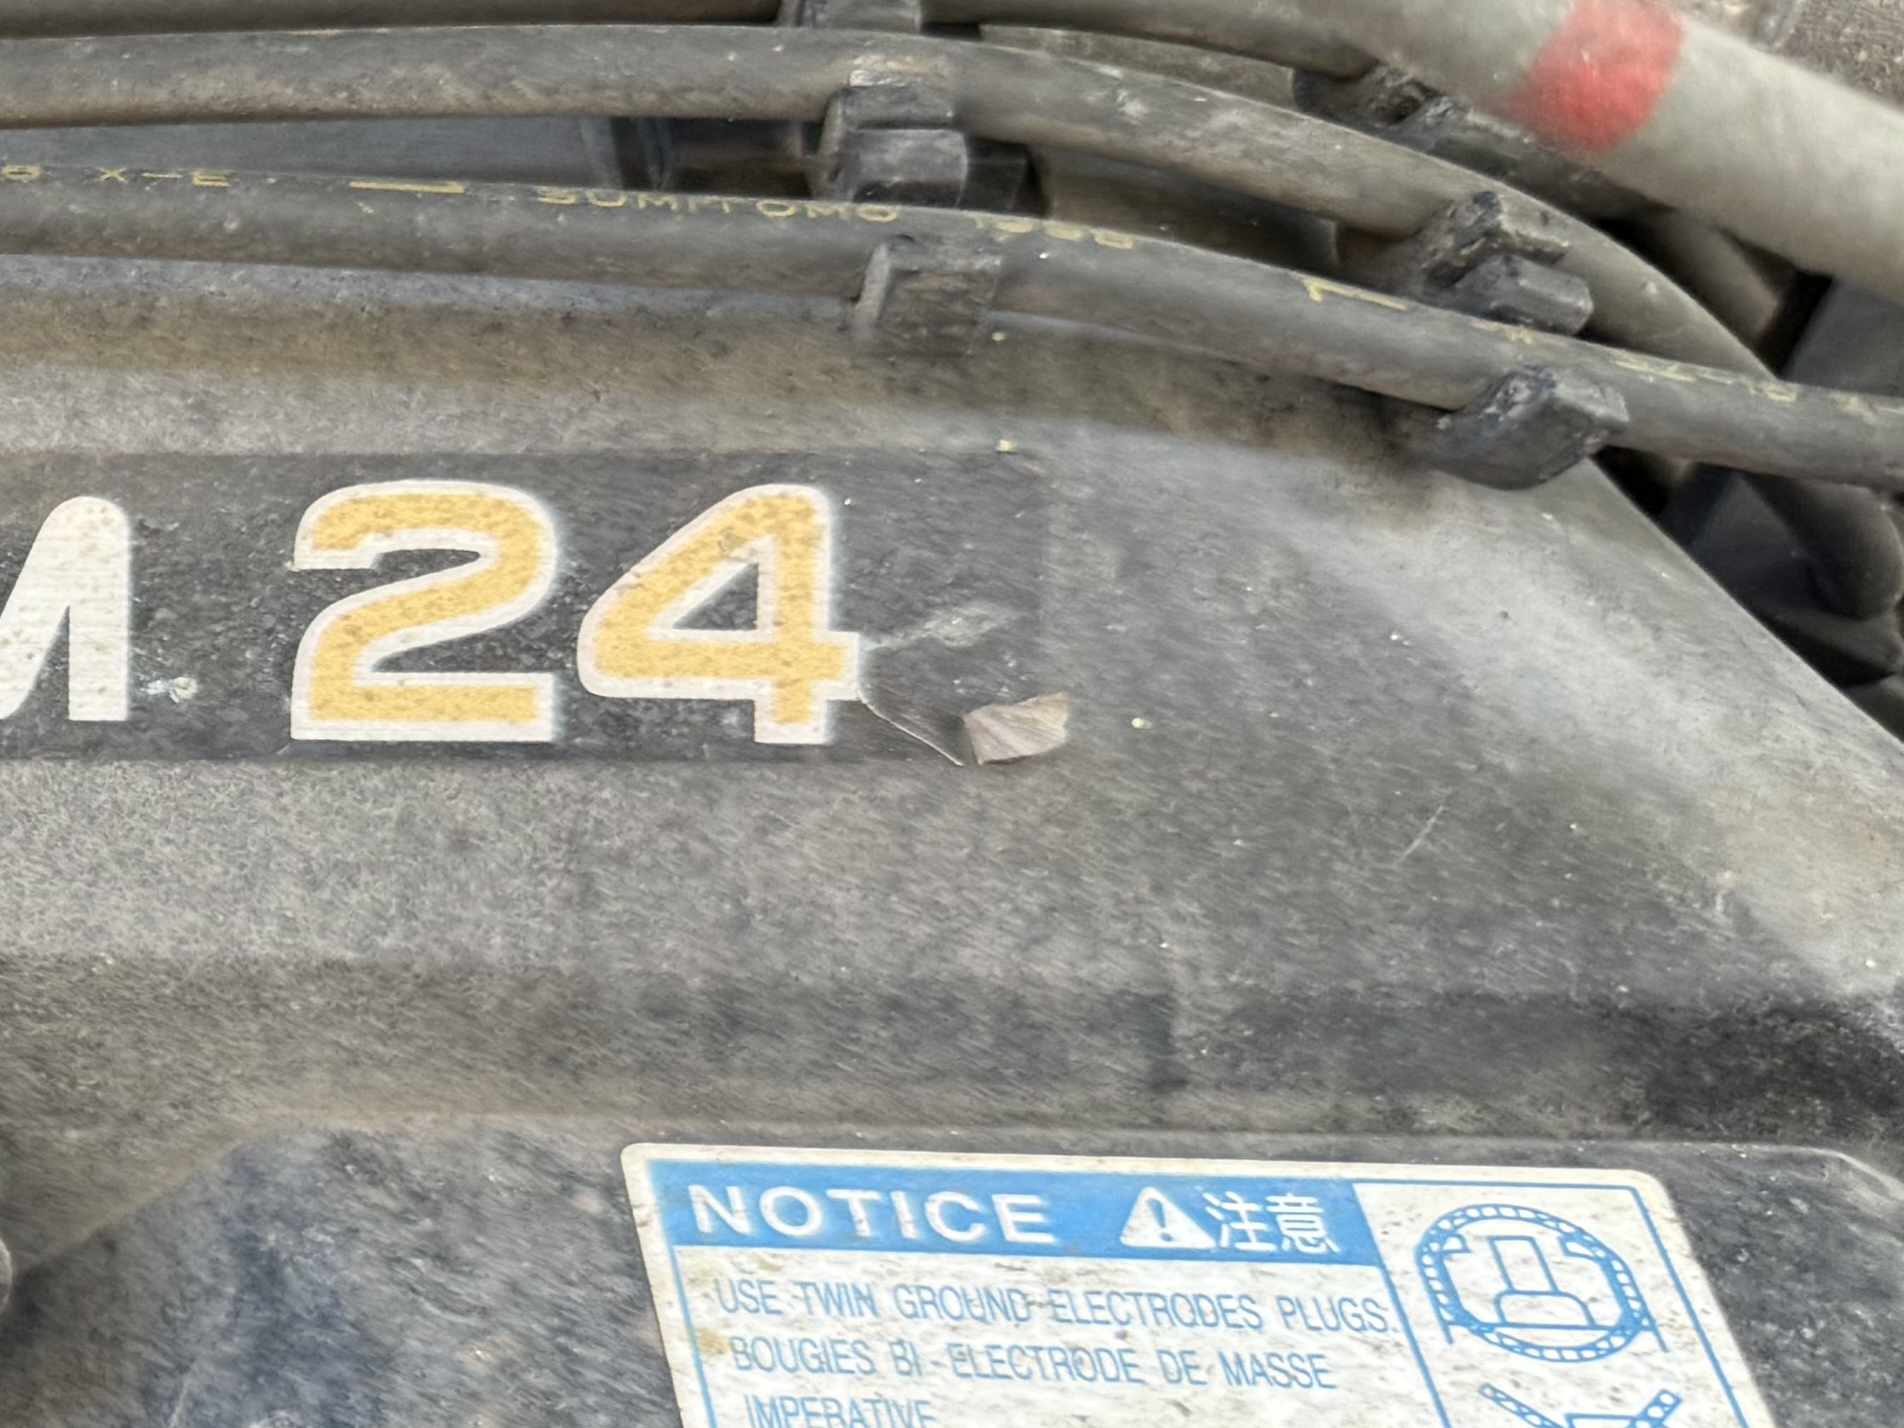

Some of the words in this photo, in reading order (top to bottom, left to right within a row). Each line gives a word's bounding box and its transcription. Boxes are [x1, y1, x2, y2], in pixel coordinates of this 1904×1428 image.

[289, 480, 860, 746] 24
[689, 1183, 1056, 1246] NOTICE
[1202, 1191, 1342, 1254] 注意
[715, 1278, 783, 1315] USE
[794, 1281, 879, 1319] TWIN
[894, 1283, 1033, 1323] GROUND
[1047, 1289, 1262, 1330] ELECTRODES
[730, 1335, 876, 1374] BOUGIES
[1156, 1349, 1207, 1386] DE
[1216, 1351, 1338, 1390] MASSE
